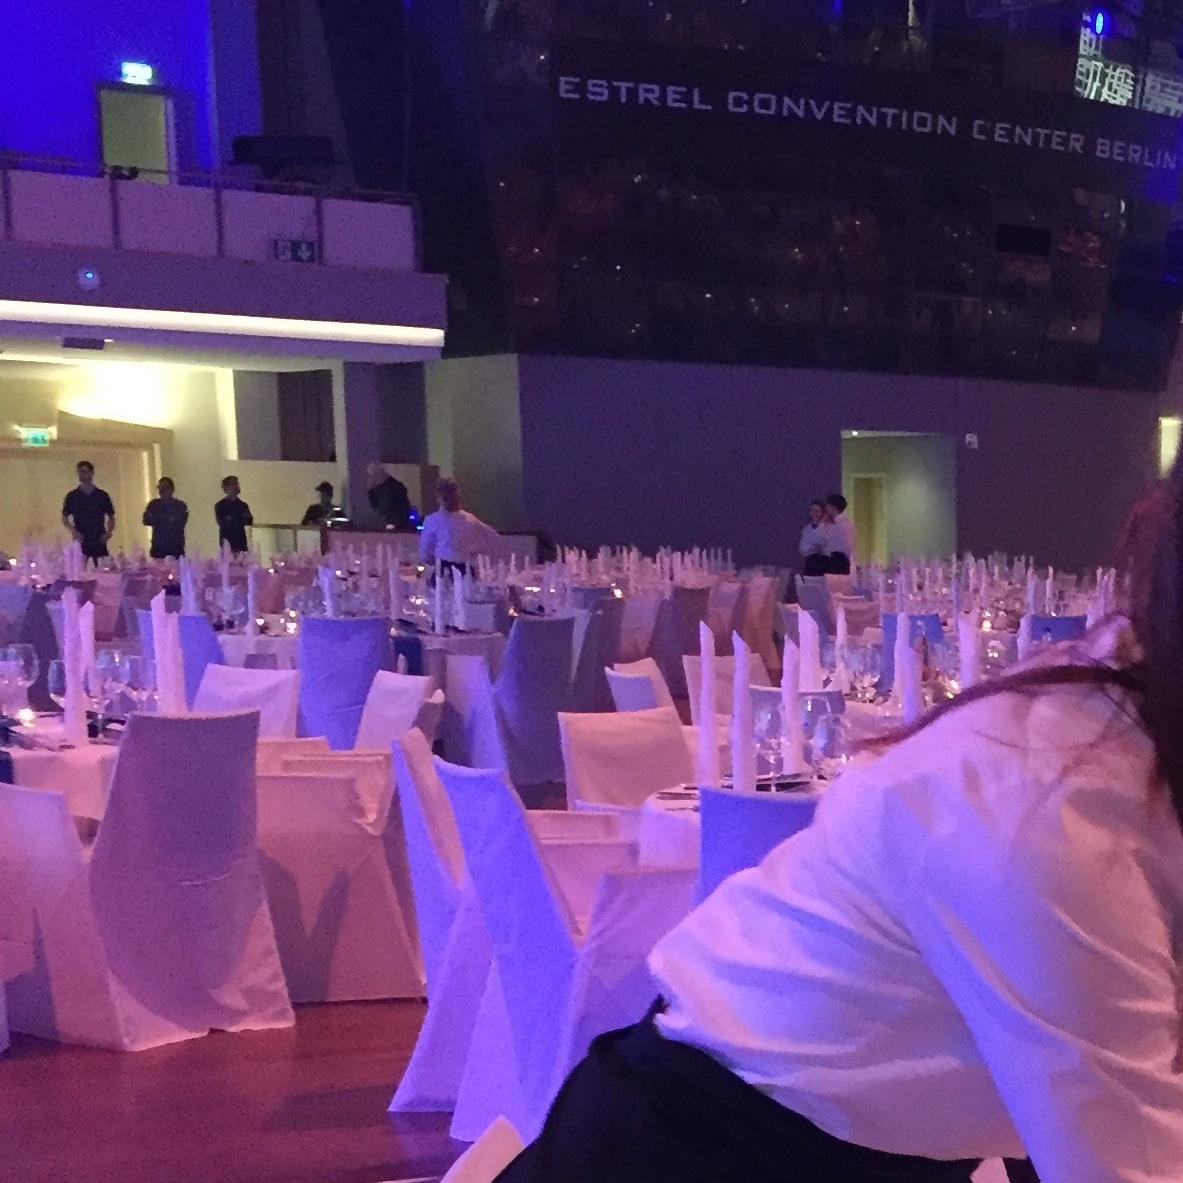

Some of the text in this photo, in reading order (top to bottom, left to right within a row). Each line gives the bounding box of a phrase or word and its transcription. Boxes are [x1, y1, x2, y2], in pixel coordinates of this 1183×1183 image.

[558, 76, 1178, 171] ESTREL CONVENTION CENTER BERLIN
